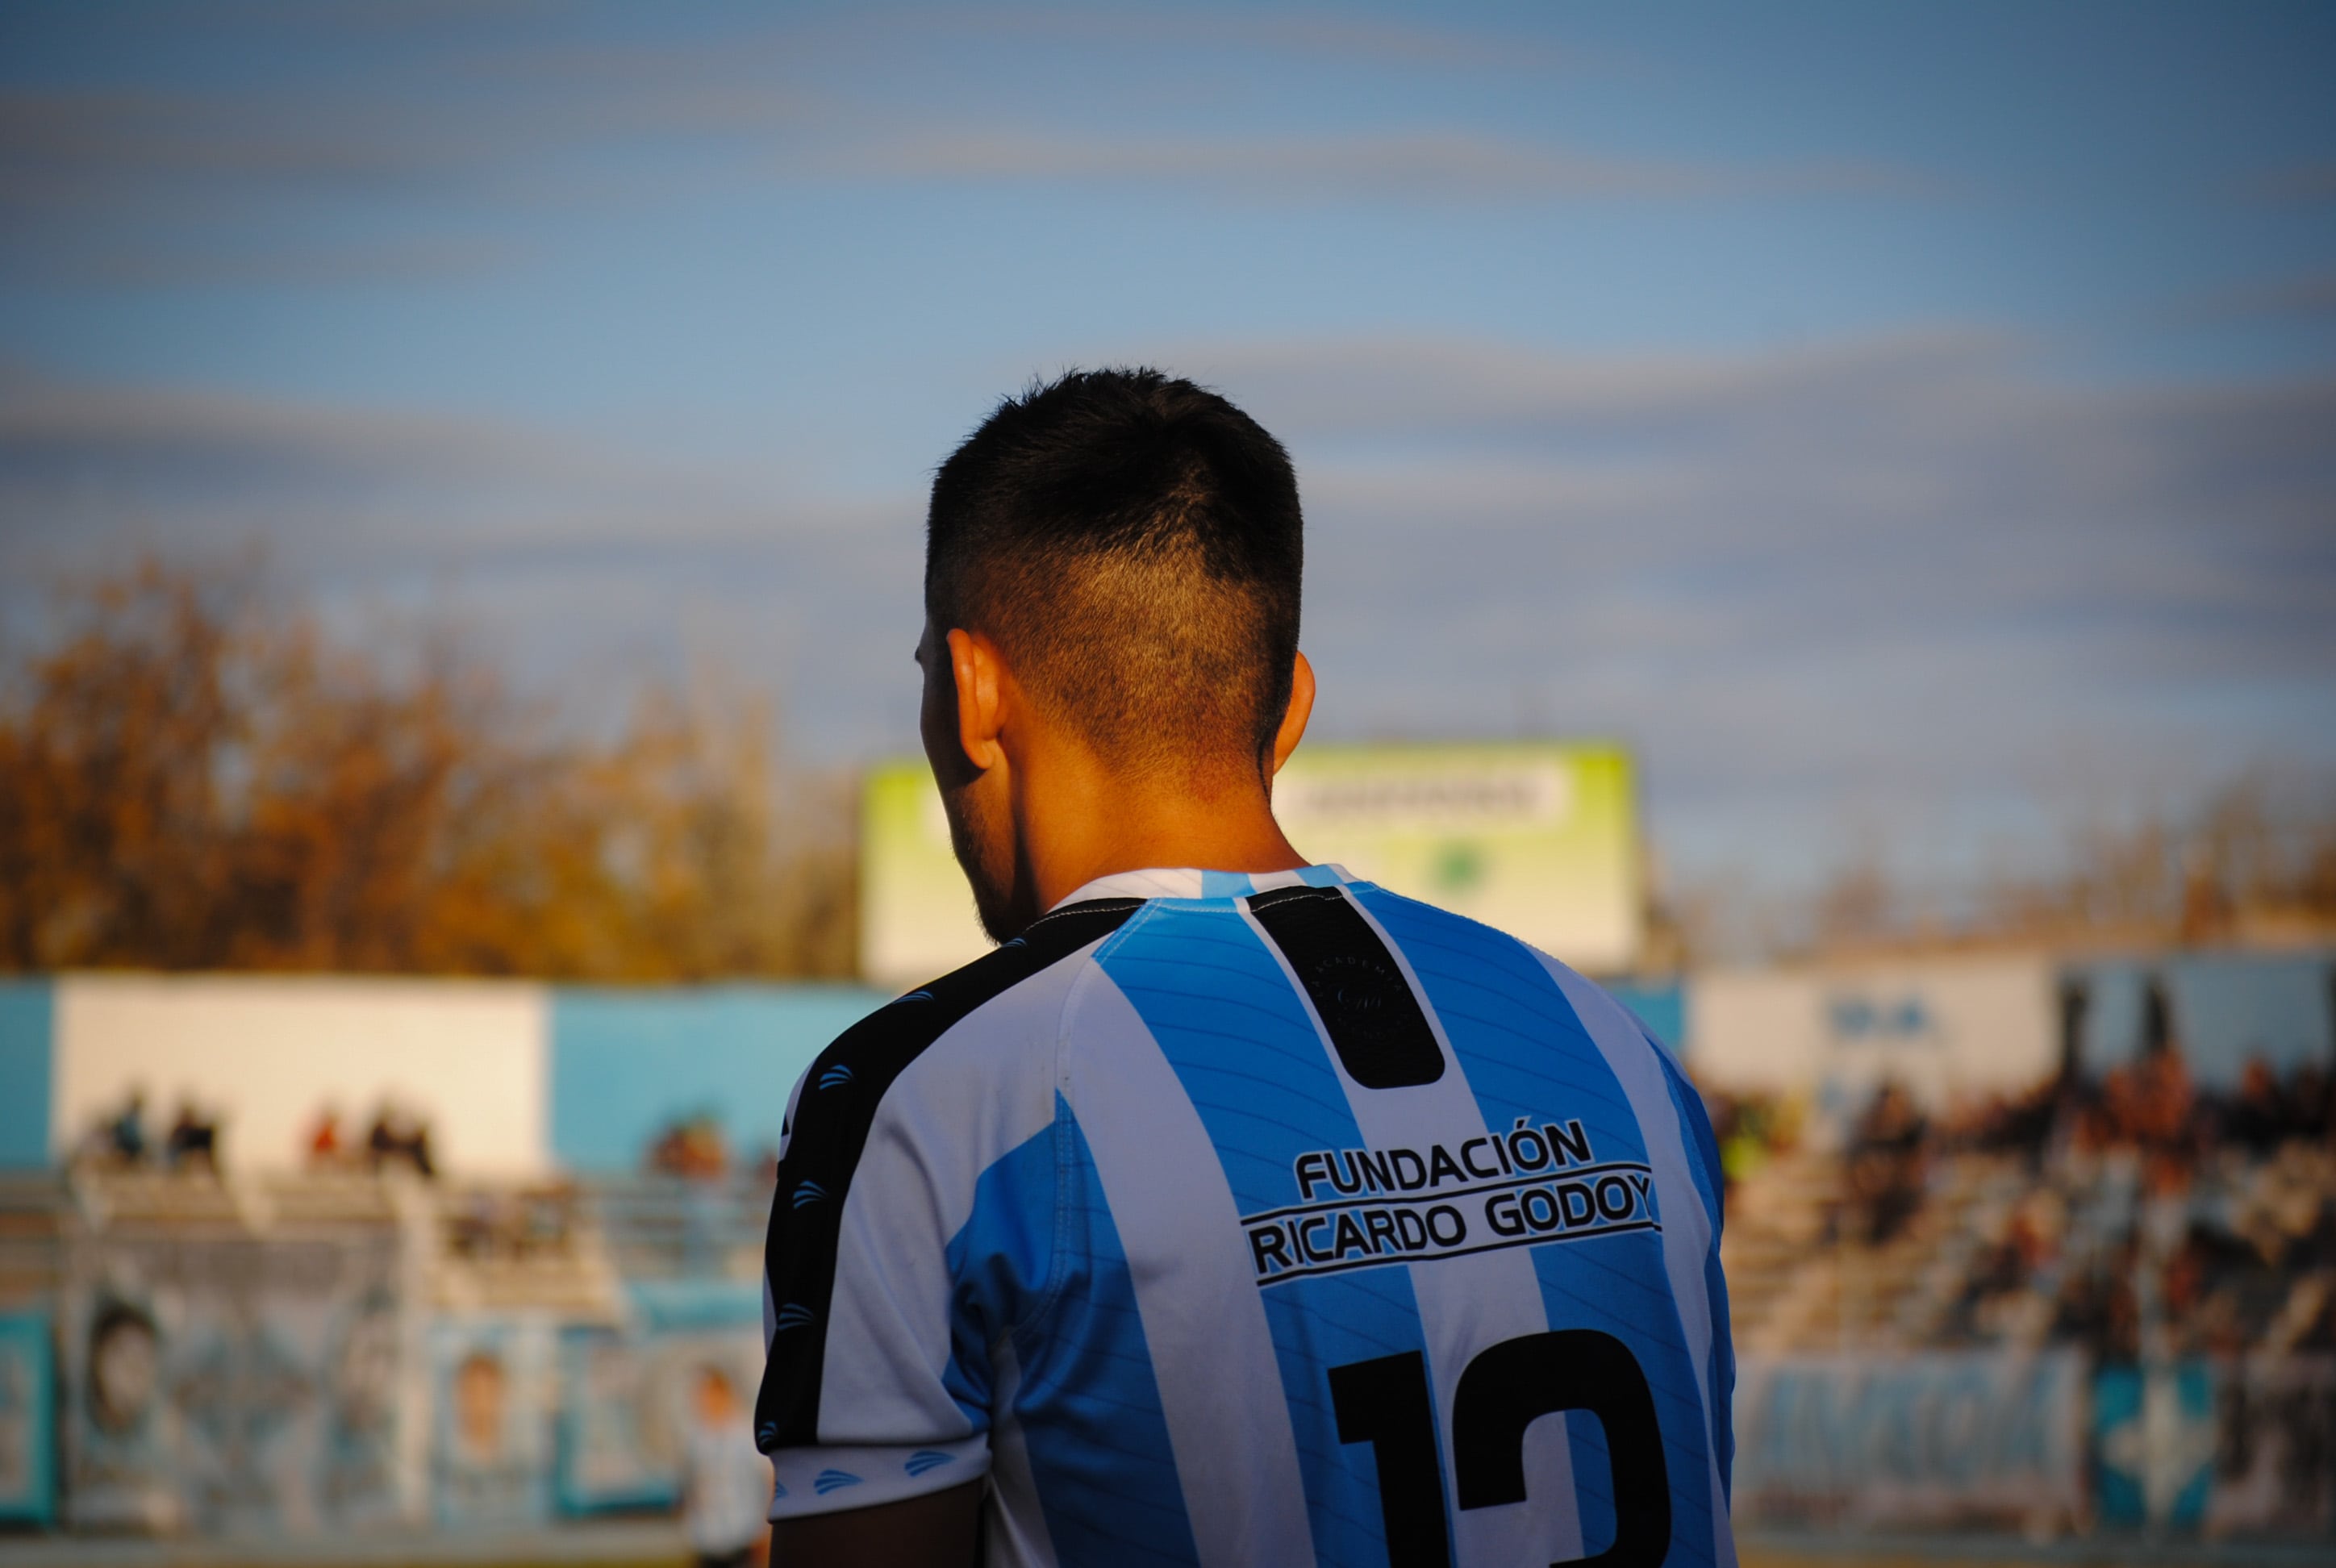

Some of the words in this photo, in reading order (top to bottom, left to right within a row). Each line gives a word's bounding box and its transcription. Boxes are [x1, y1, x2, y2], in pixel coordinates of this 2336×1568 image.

[1295, 1118, 1591, 1199] FUNDACIÓN
[1249, 1204, 1467, 1274] RICARDO
[1486, 1174, 1651, 1236] GODOY
